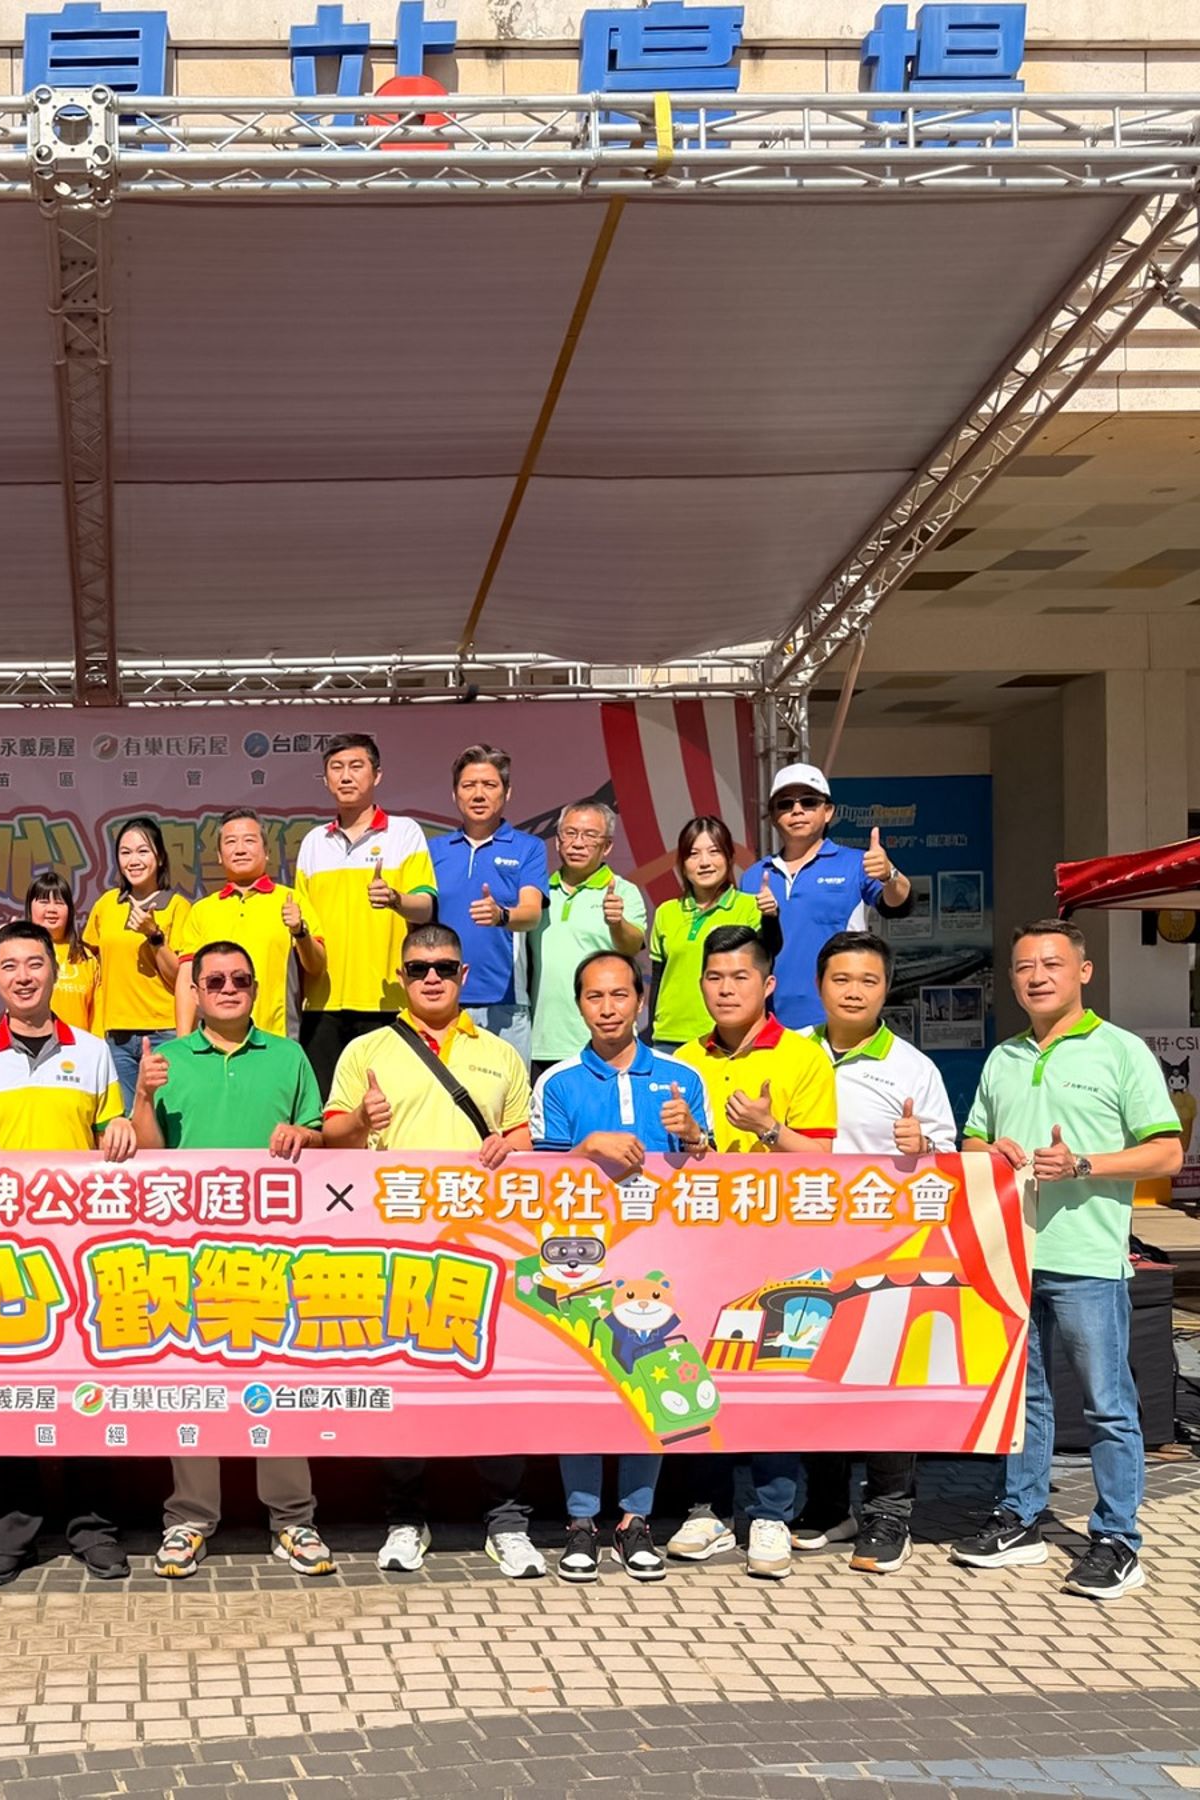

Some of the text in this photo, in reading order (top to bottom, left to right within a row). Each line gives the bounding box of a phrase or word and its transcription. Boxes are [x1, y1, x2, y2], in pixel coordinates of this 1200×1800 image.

[0, 737, 76, 758] 永義房屋
[123, 735, 229, 756] 有巢氏房屋
[379, 1170, 957, 1223] 喜憨兒社會福利基金會
[90, 1241, 499, 1366] 歡樂無限
[108, 1386, 228, 1411] 有巢氏房屋
[274, 1386, 392, 1411] 台慶不動產
